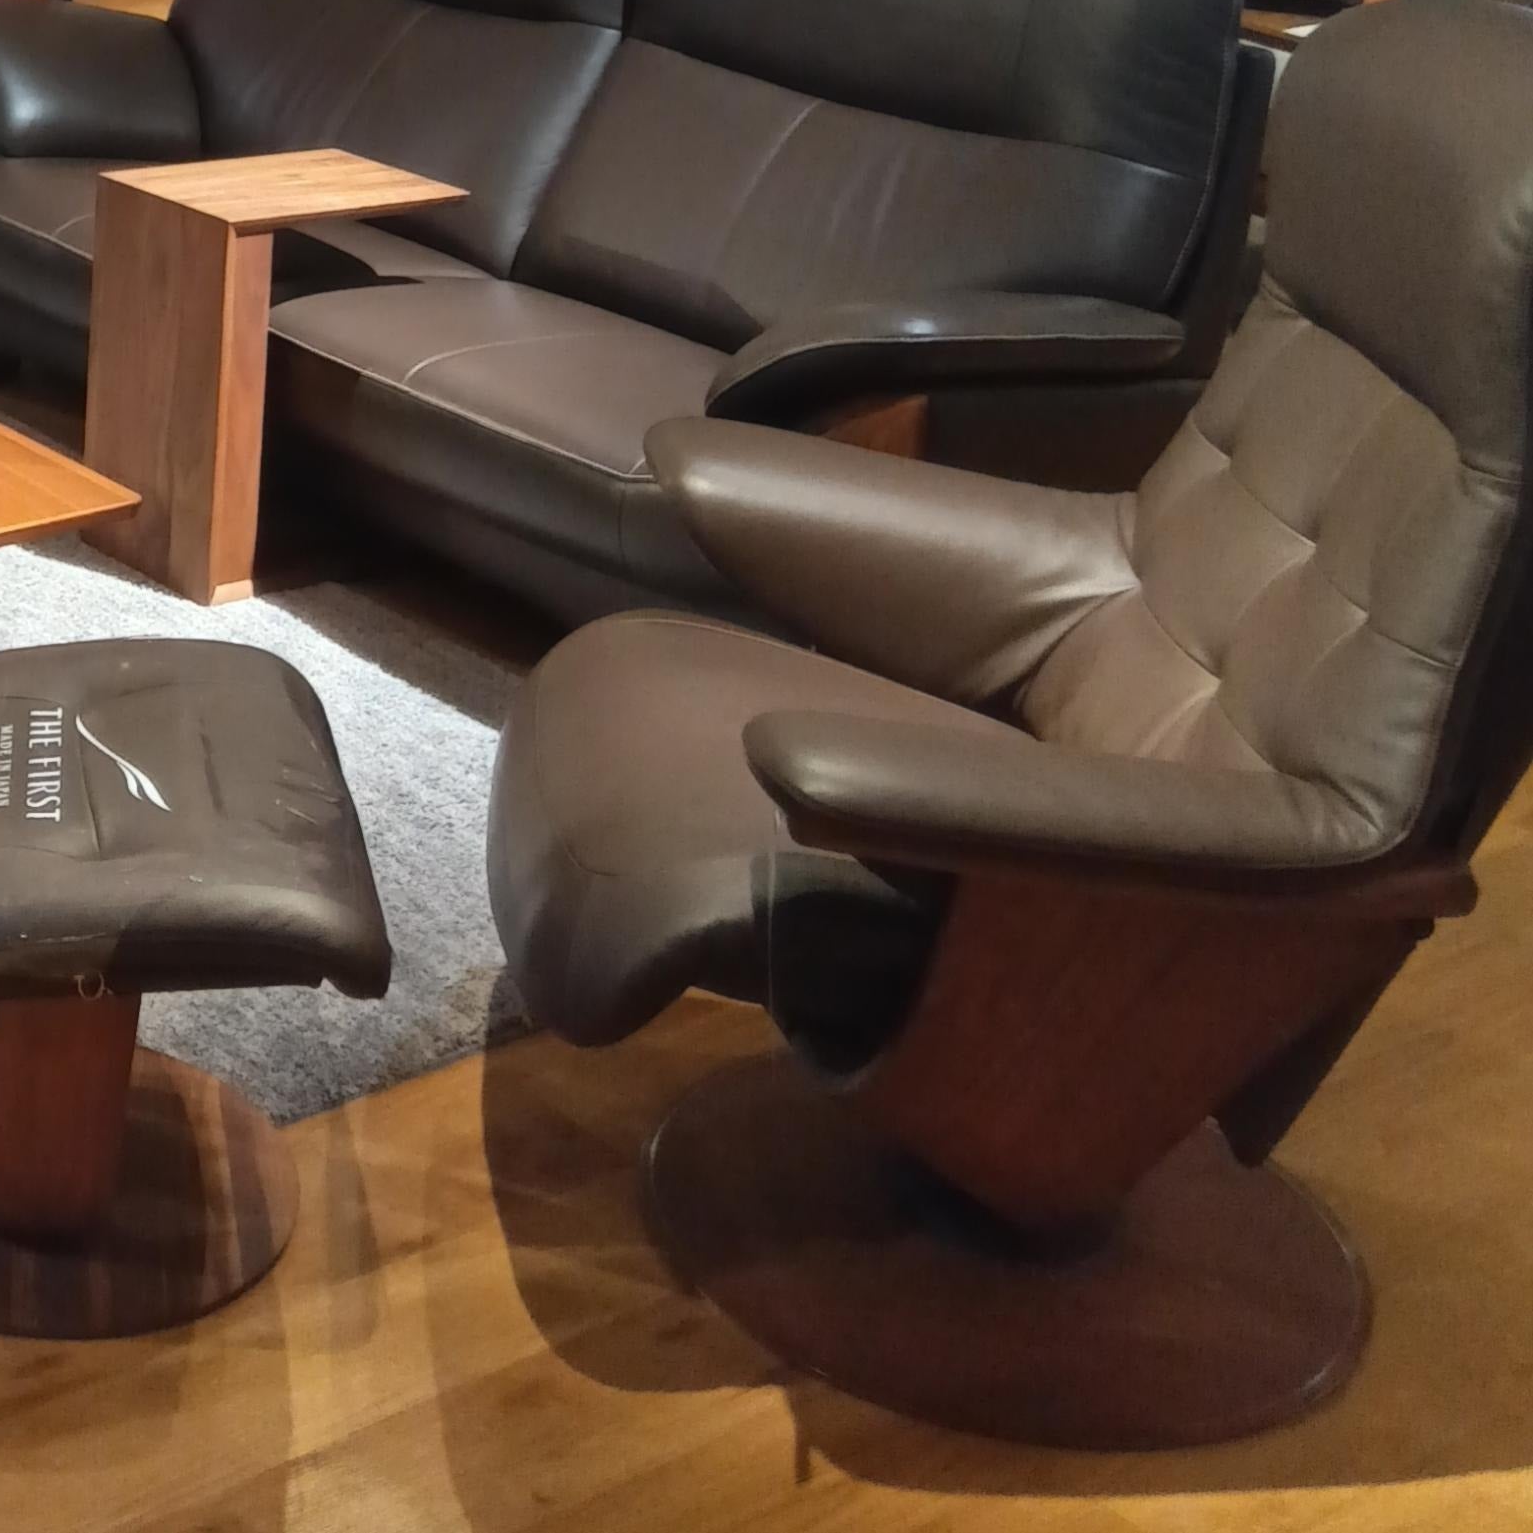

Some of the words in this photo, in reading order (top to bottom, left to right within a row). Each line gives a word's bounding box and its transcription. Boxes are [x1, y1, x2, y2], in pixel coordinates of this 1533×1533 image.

[0, 724, 14, 756] MADE
[28, 707, 63, 749] THE
[26, 756, 62, 822] FIRST
